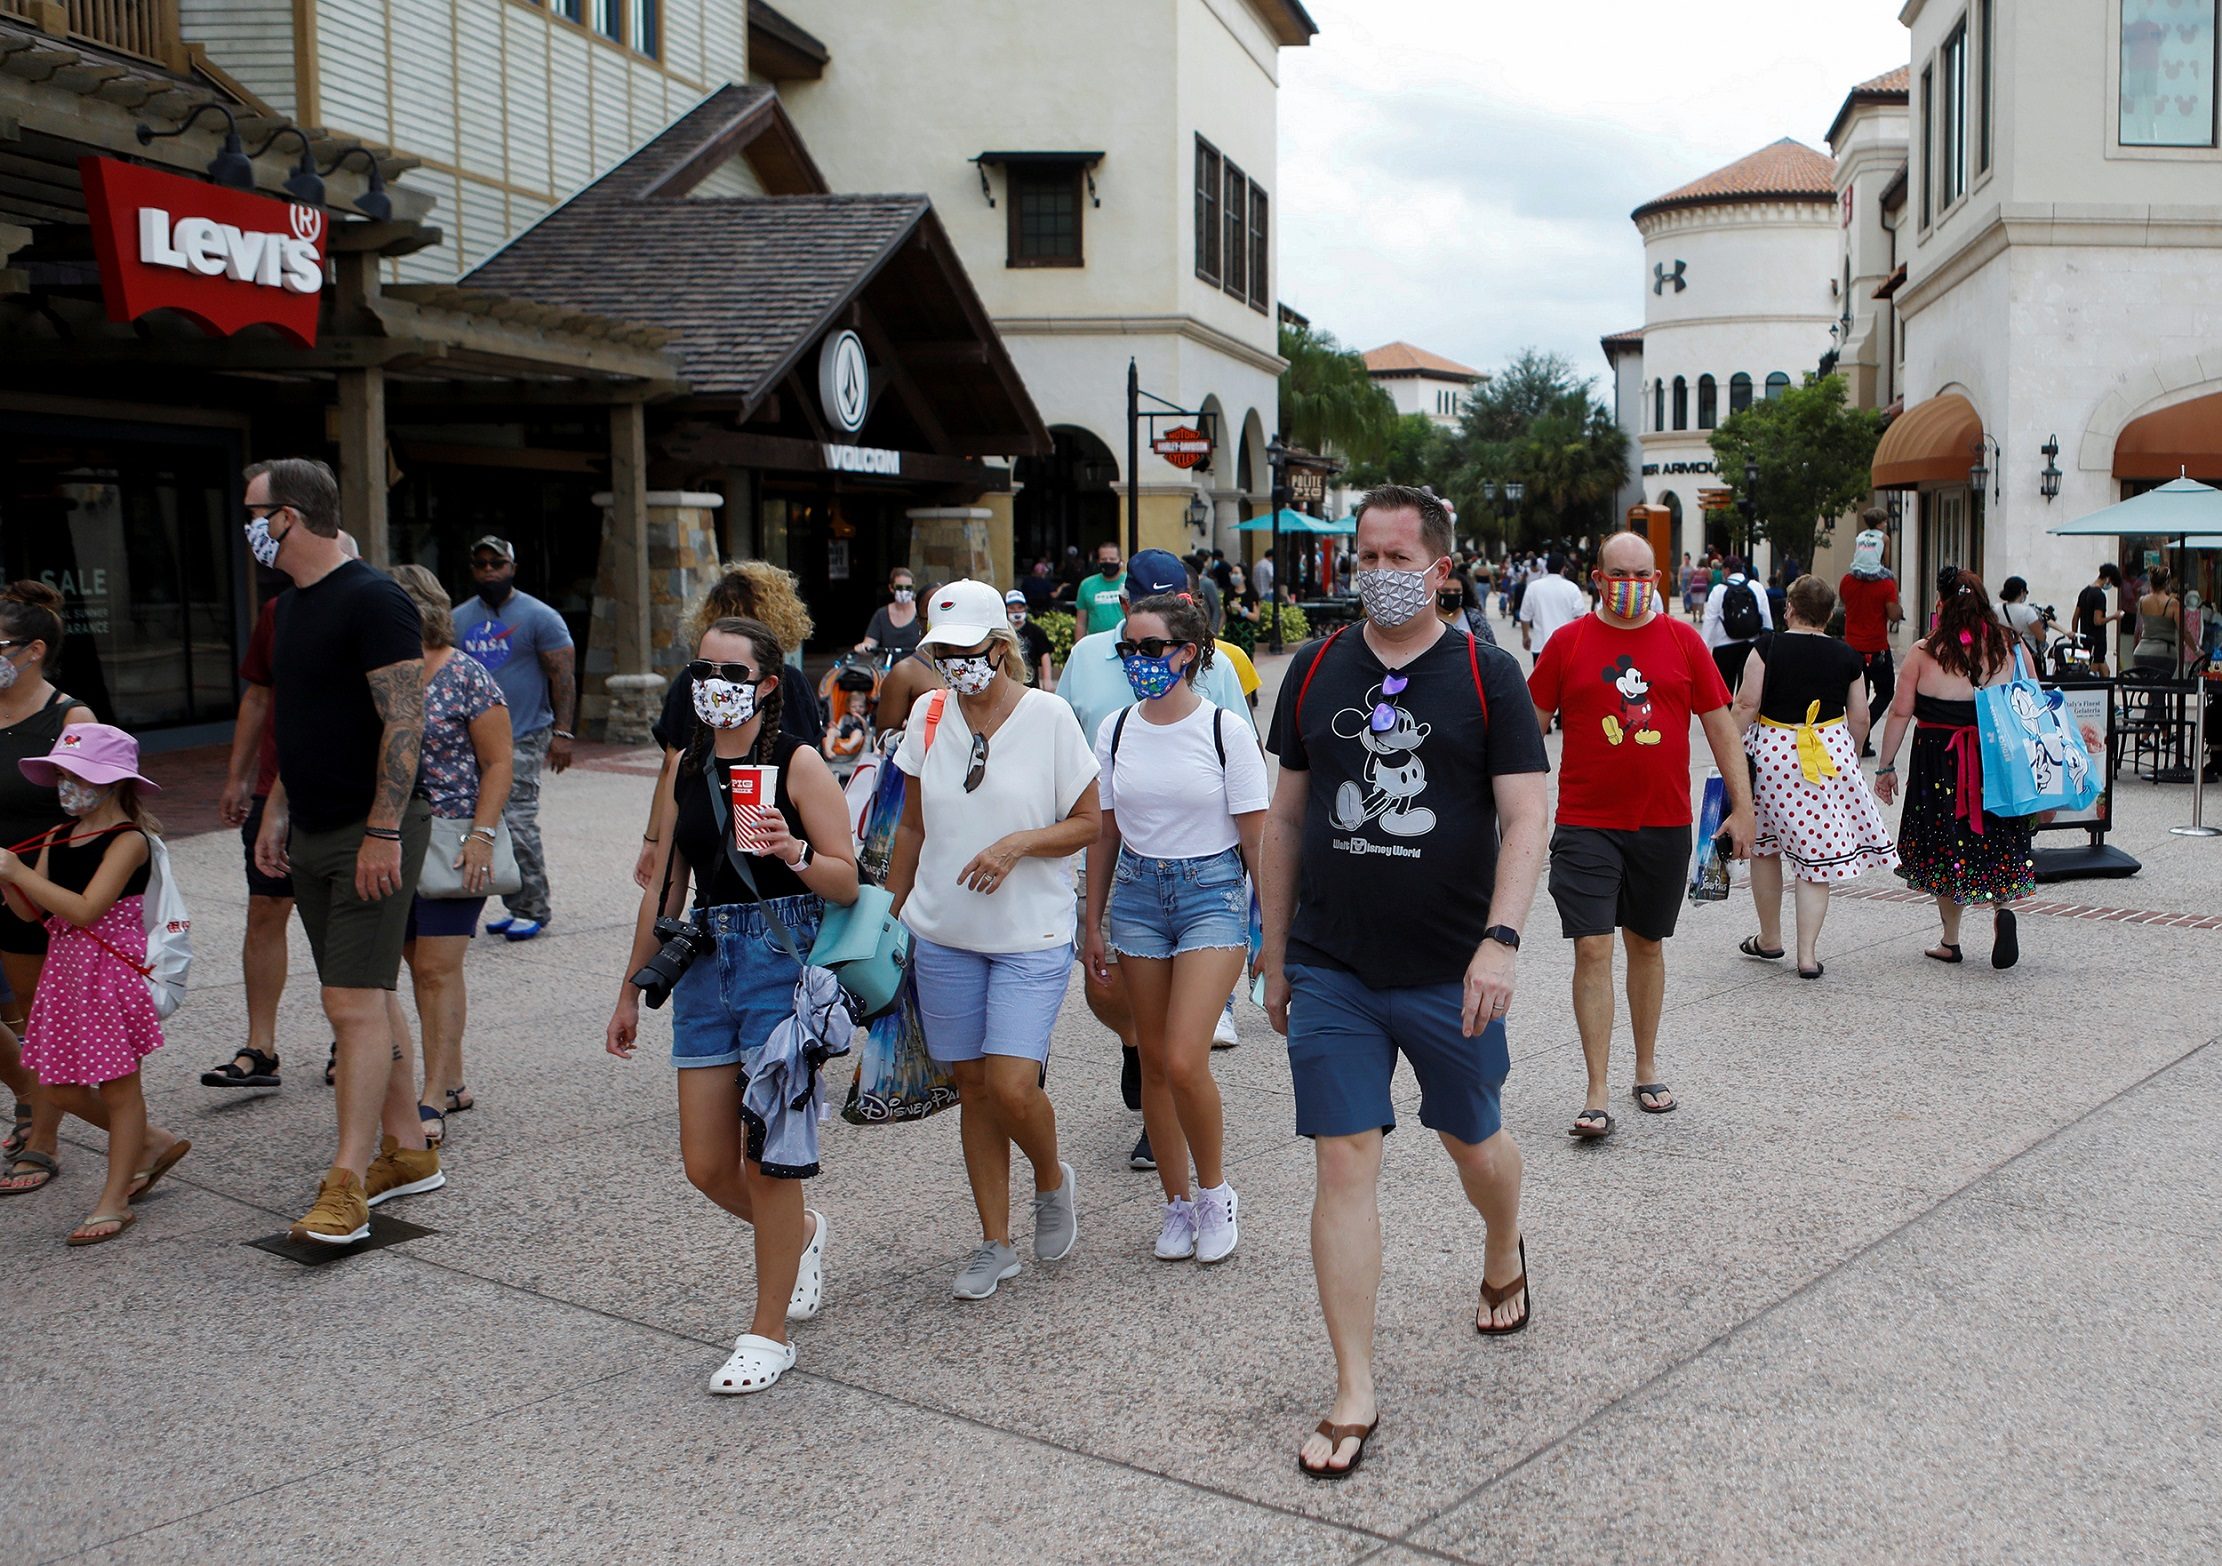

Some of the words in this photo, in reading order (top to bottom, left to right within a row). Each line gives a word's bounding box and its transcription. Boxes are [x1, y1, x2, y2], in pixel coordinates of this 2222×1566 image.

[823, 444, 900, 474] VOLCOM
[41, 569, 108, 596] SALE
[465, 638, 510, 652] NASA
[1333, 838, 1350, 851] Walt
[1392, 844, 1421, 859] World
